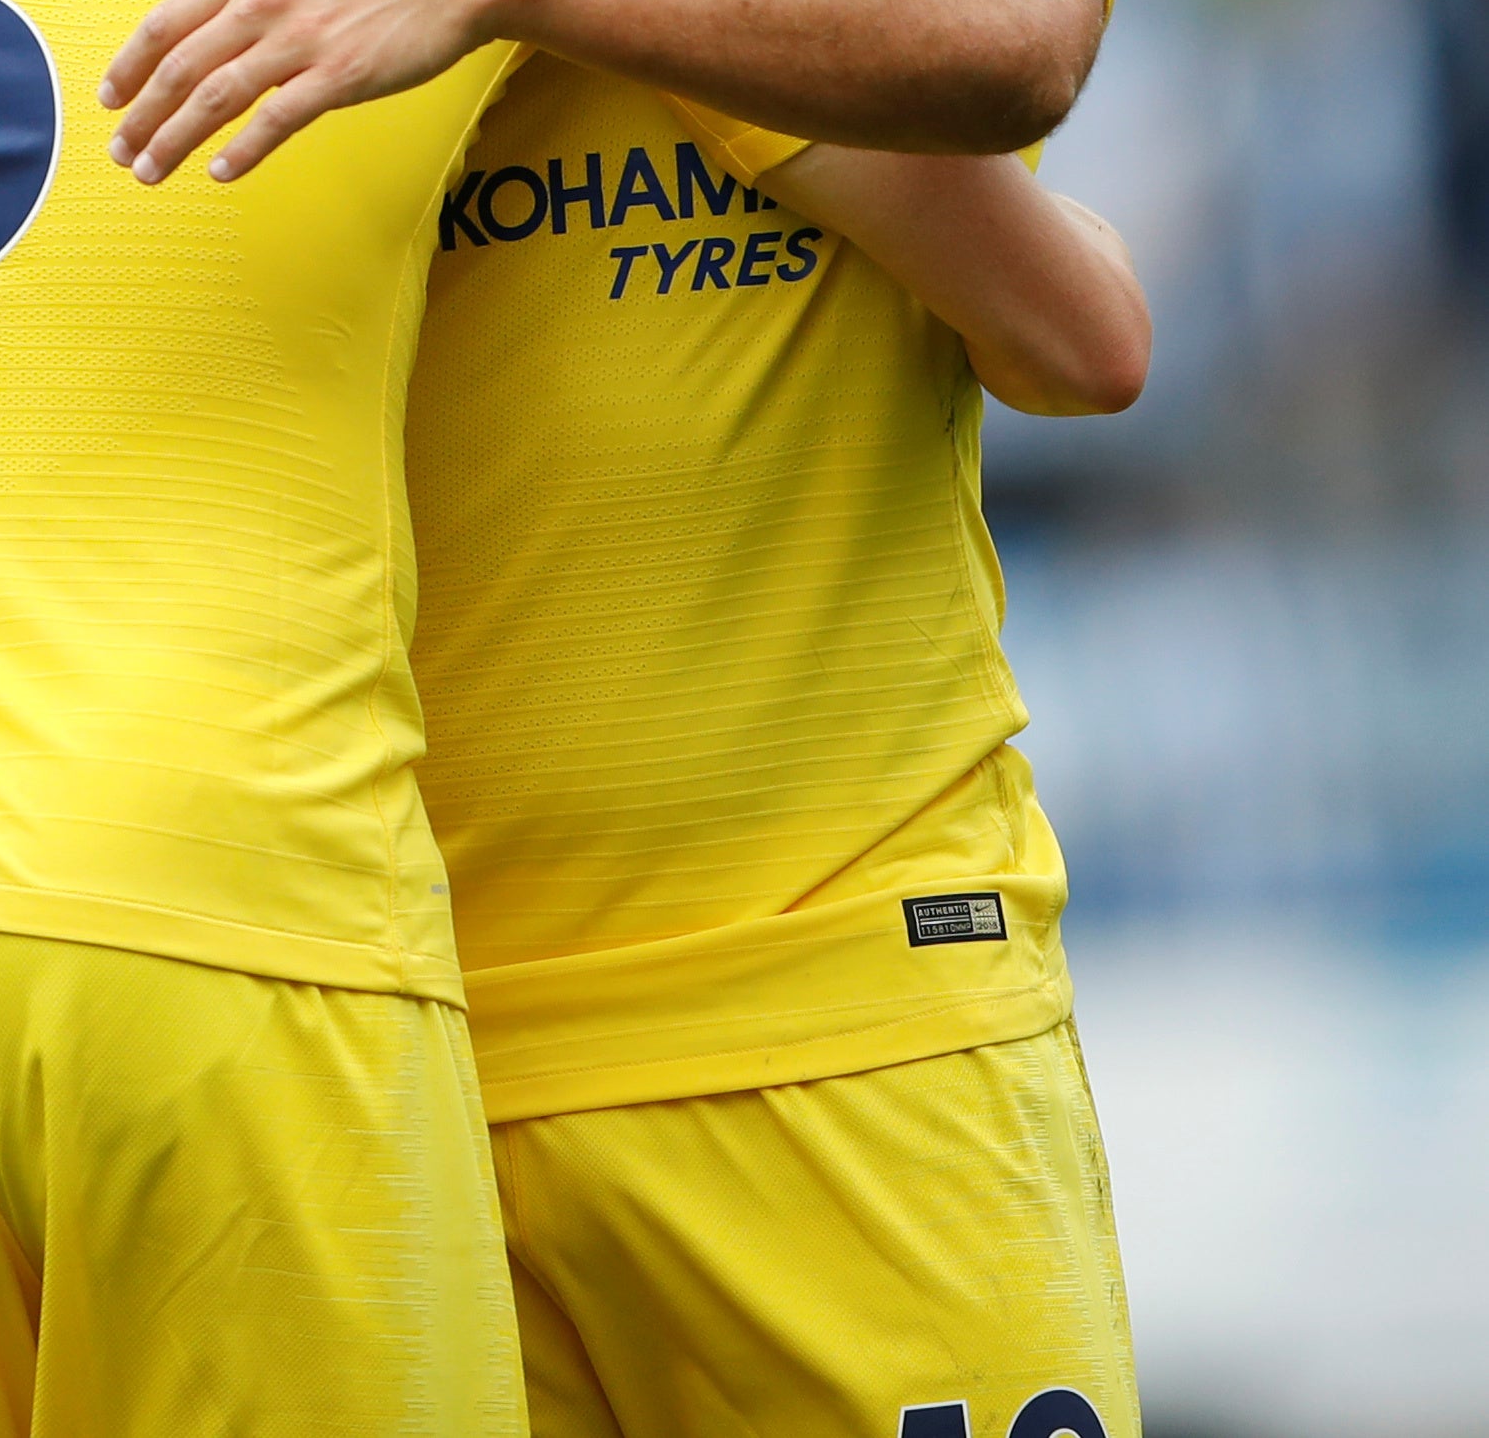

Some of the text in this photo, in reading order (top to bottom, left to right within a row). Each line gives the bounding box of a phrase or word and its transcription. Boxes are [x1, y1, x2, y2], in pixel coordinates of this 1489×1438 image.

[439, 142, 778, 252] KOHAM
[609, 227, 823, 300] TYRES
[917, 904, 969, 917] AUTHENTIC
